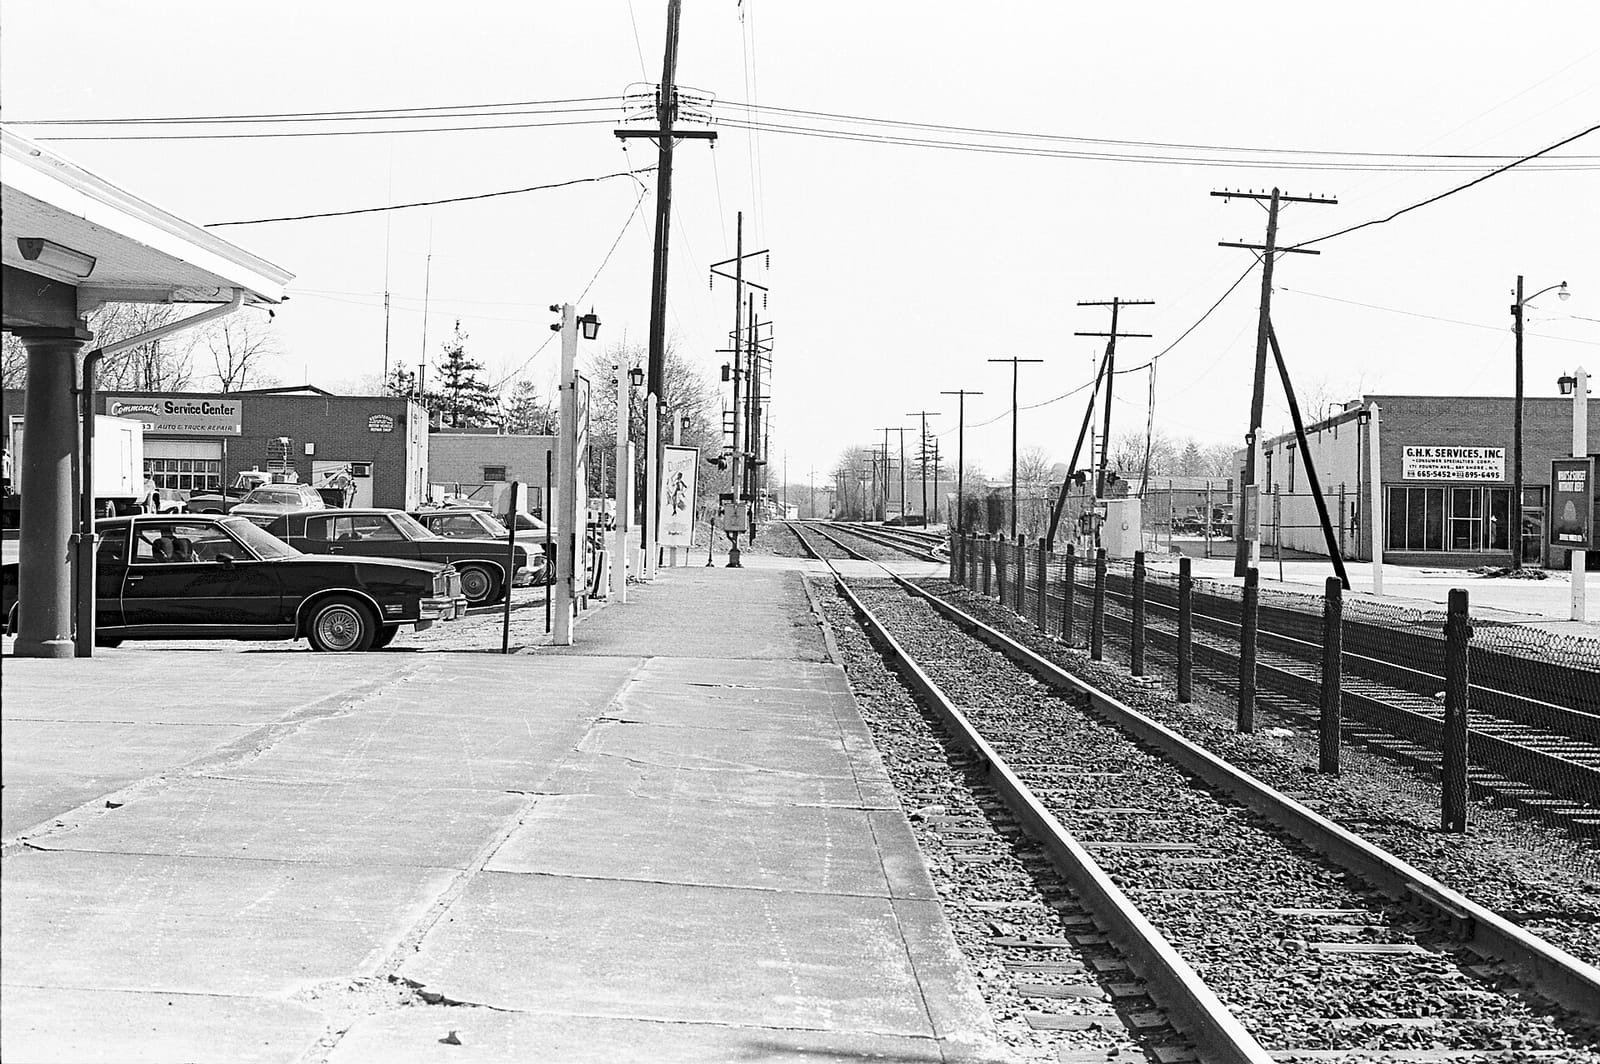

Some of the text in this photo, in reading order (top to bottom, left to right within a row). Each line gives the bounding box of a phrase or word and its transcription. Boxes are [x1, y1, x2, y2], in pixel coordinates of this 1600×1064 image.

[164, 401, 200, 415] Service
[201, 402, 235, 415] Center
[1406, 448, 1433, 457] G.H.K.
[1485, 450, 1503, 458] INC.
